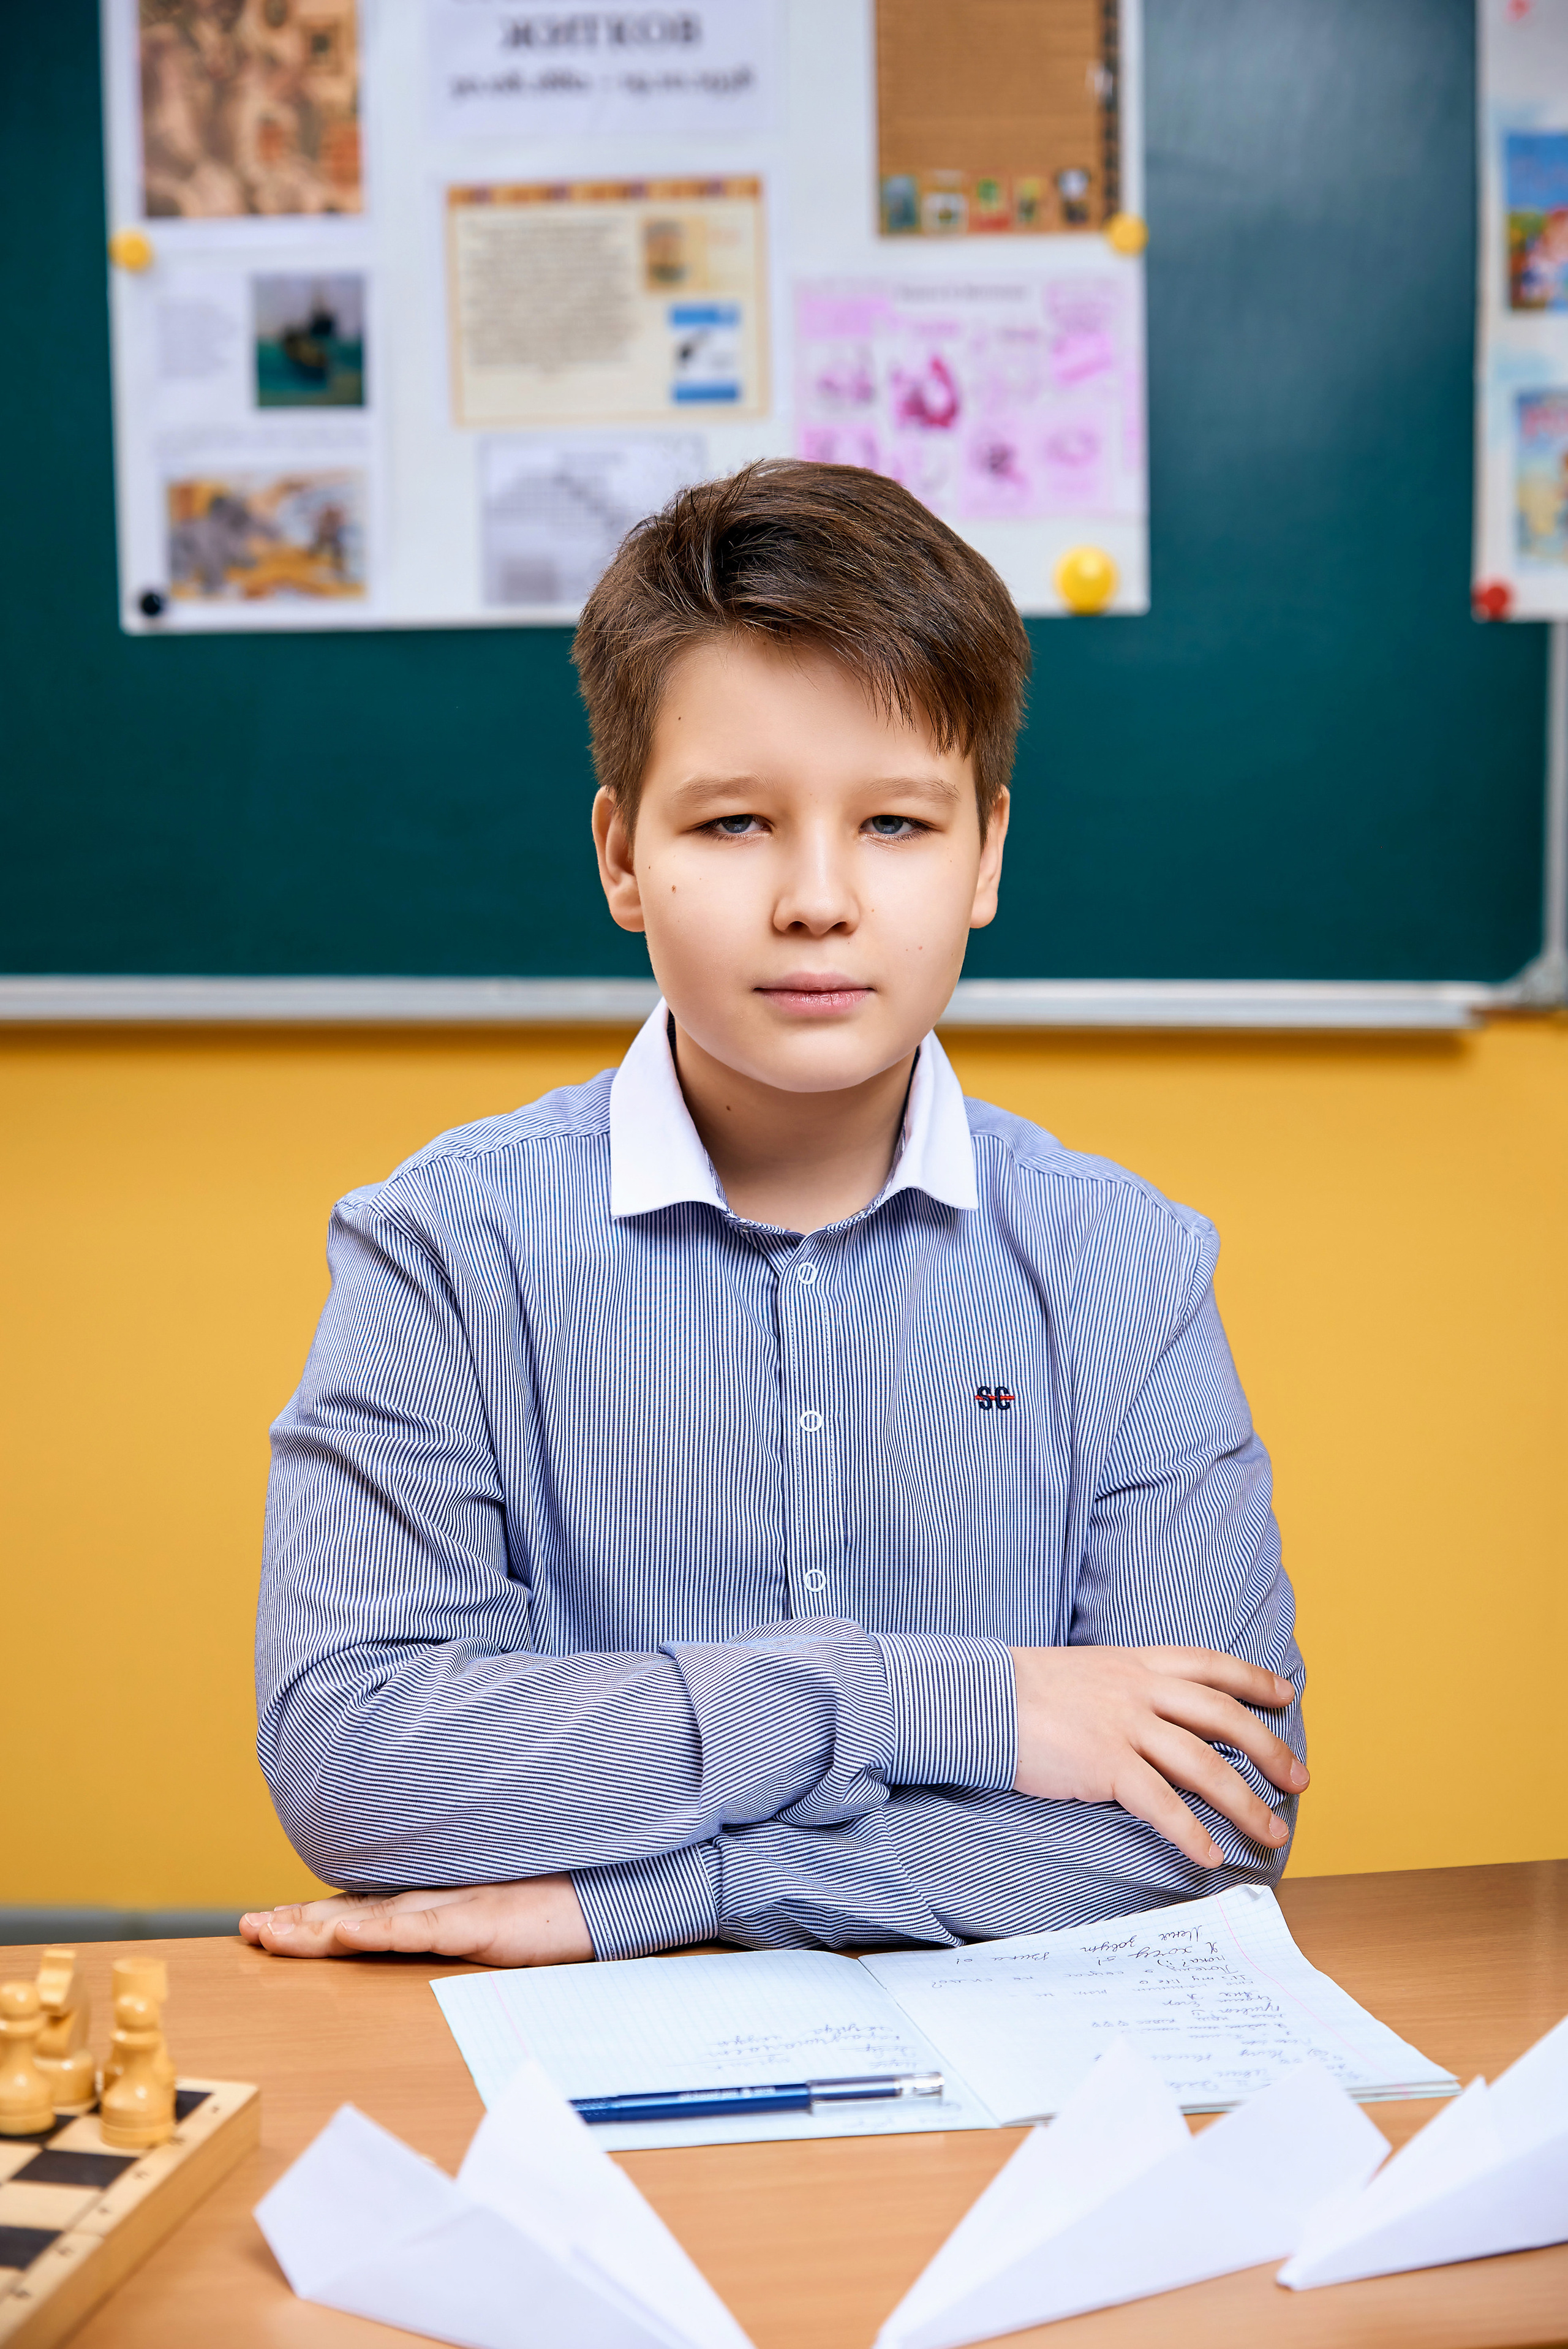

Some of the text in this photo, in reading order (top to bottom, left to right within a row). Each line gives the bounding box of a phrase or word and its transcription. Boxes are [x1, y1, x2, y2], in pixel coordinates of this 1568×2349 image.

[1158, 1925, 1202, 1942] Меня
[1080, 1934, 1137, 1953] зовут
[1205, 1942, 1218, 1955] Я
[1127, 1946, 1193, 1959] хочу
[1163, 1964, 1238, 1975] Почему
